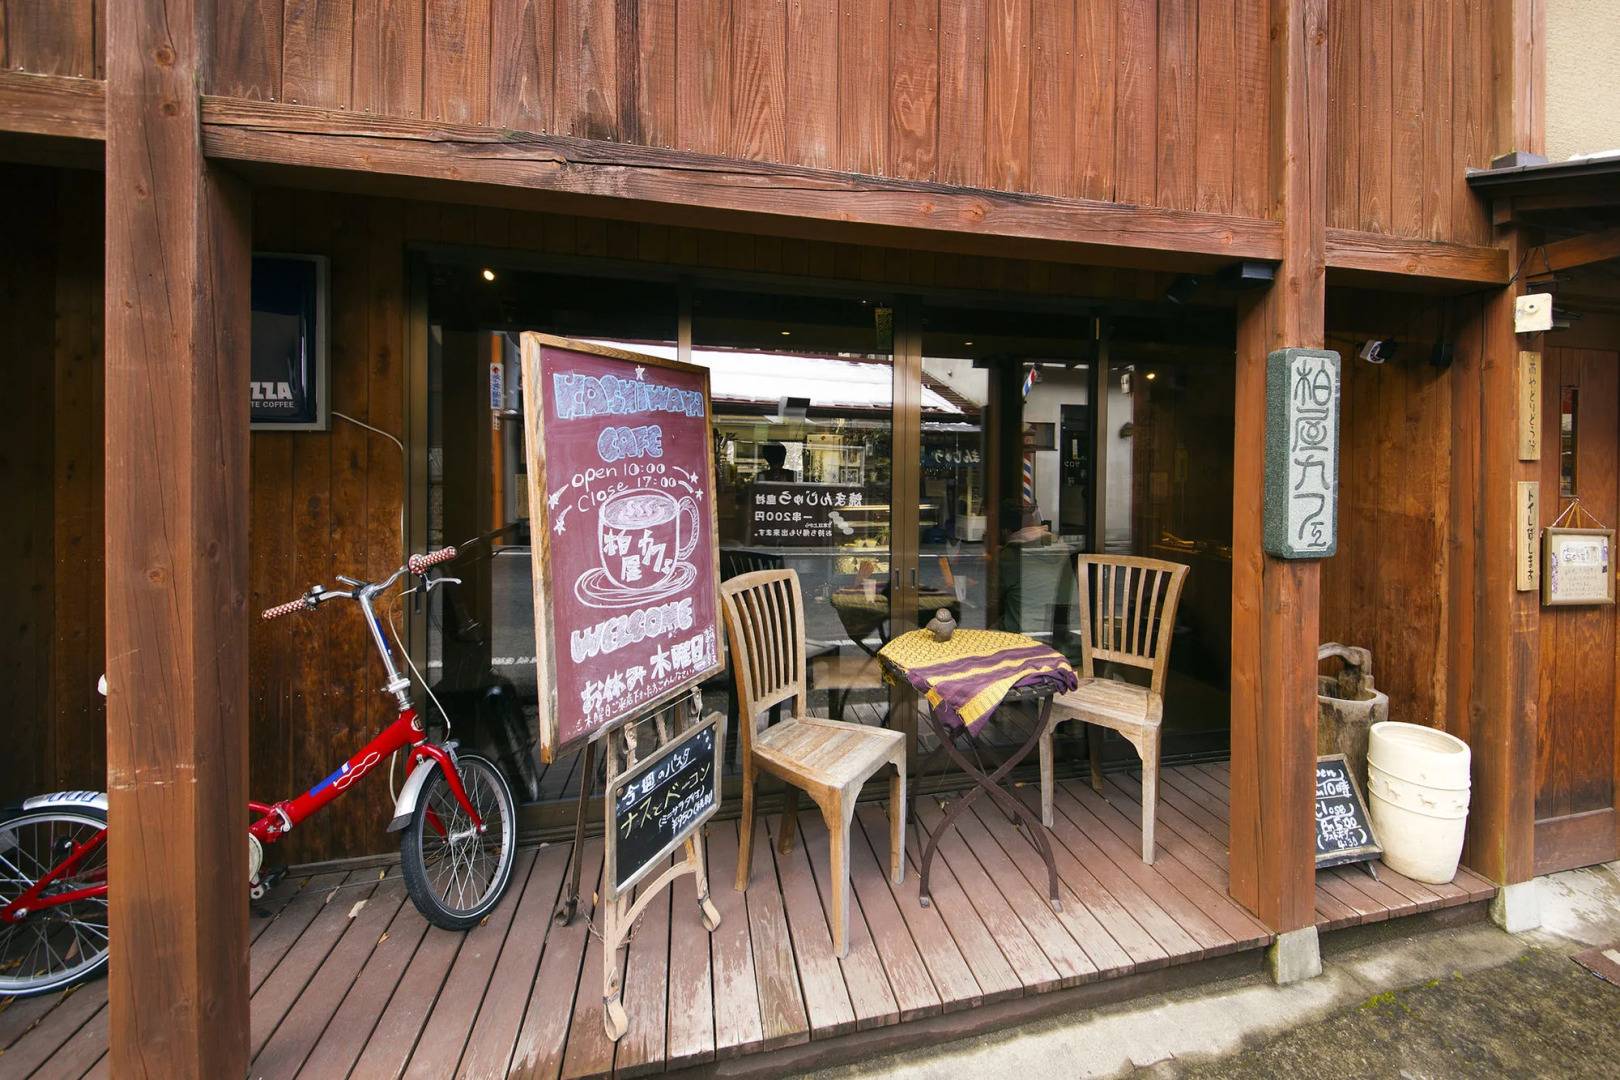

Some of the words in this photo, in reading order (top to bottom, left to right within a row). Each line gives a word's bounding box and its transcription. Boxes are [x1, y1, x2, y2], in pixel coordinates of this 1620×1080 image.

[250, 382, 293, 399] ZZA
[553, 371, 704, 419] KASHIWAYA
[597, 425, 663, 462] CAFE
[624, 463, 666, 477] 10:00
[637, 477, 676, 488] 17:00
[571, 597, 692, 663] WELCOME
[622, 748, 690, 805] 今週のパスタ
[620, 762, 710, 839] ナスとベーコン
